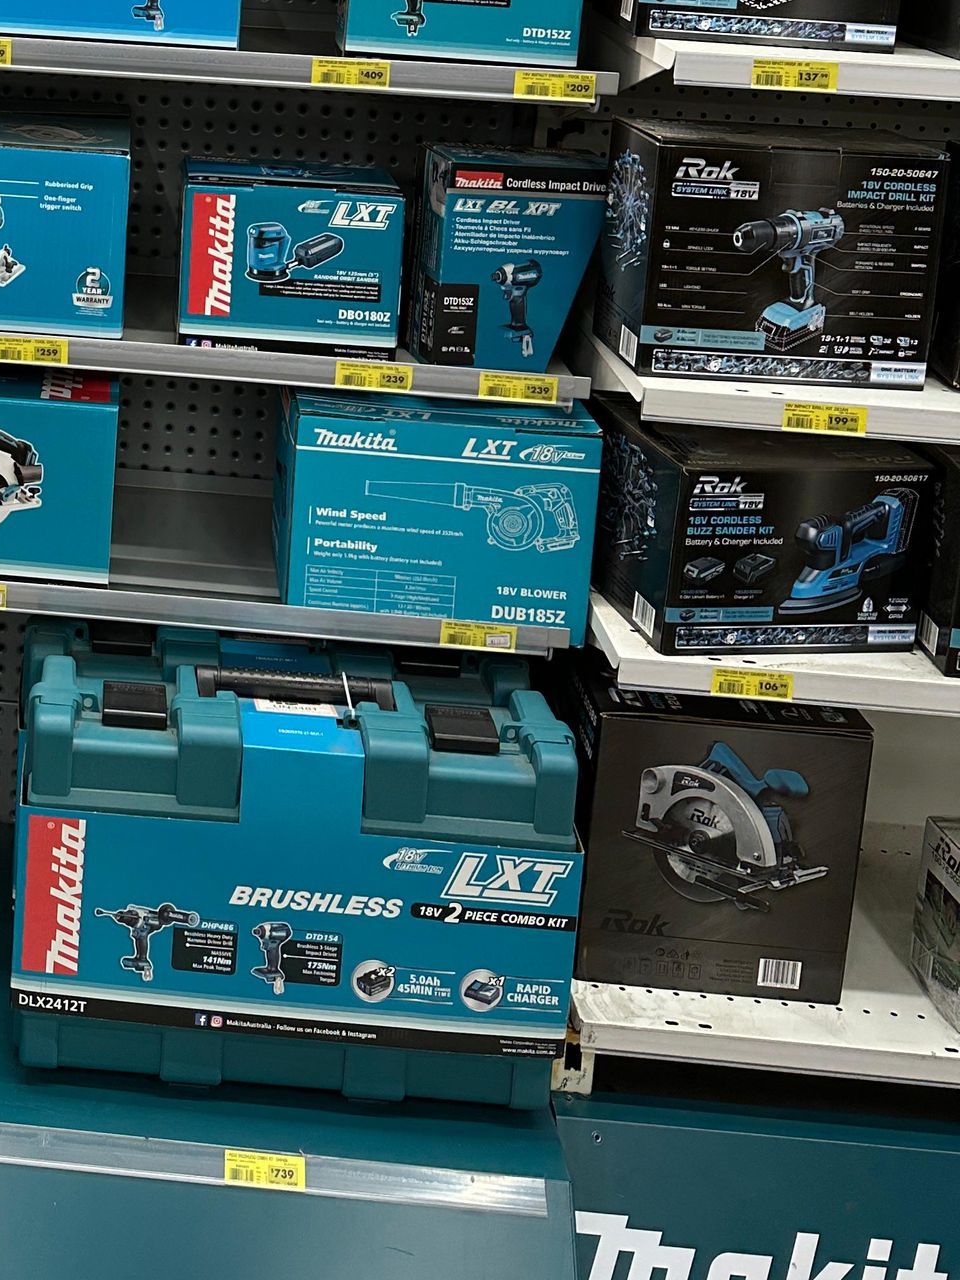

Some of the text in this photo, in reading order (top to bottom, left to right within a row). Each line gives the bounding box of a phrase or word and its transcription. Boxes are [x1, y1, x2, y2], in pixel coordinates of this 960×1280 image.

[523, 27, 571, 40] DTD152Z
[566, 83, 590, 93] $209
[676, 158, 741, 180] Rok
[506, 178, 546, 190] Cordless
[548, 180, 577, 192] Impact
[861, 180, 937, 192] 18V CORDLESS
[328, 201, 397, 229] LXT
[76, 296, 110, 304] WARRANTY
[444, 296, 474, 306] DTD153Z
[338, 310, 391, 323] DBO180Z
[36, 347, 58, 357] $259
[461, 437, 518, 460] LXT
[693, 475, 747, 495] Rok
[316, 508, 387, 521] Wind Speed
[687, 526, 775, 536] BUZZ SANDER KIT
[314, 538, 378, 553] Portability
[496, 587, 567, 600] 18V BLOWER
[491, 605, 566, 624] DUB185Z
[440, 852, 574, 907] LXT
[229, 886, 403, 918] BRUSHLESS
[409, 974, 440, 987] 5.0Ah
[516, 983, 551, 995] RAPID
[18, 993, 87, 1013] DLX2412T
[507, 992, 559, 1006] CHARGER
[270, 1166, 295, 1182] $739
